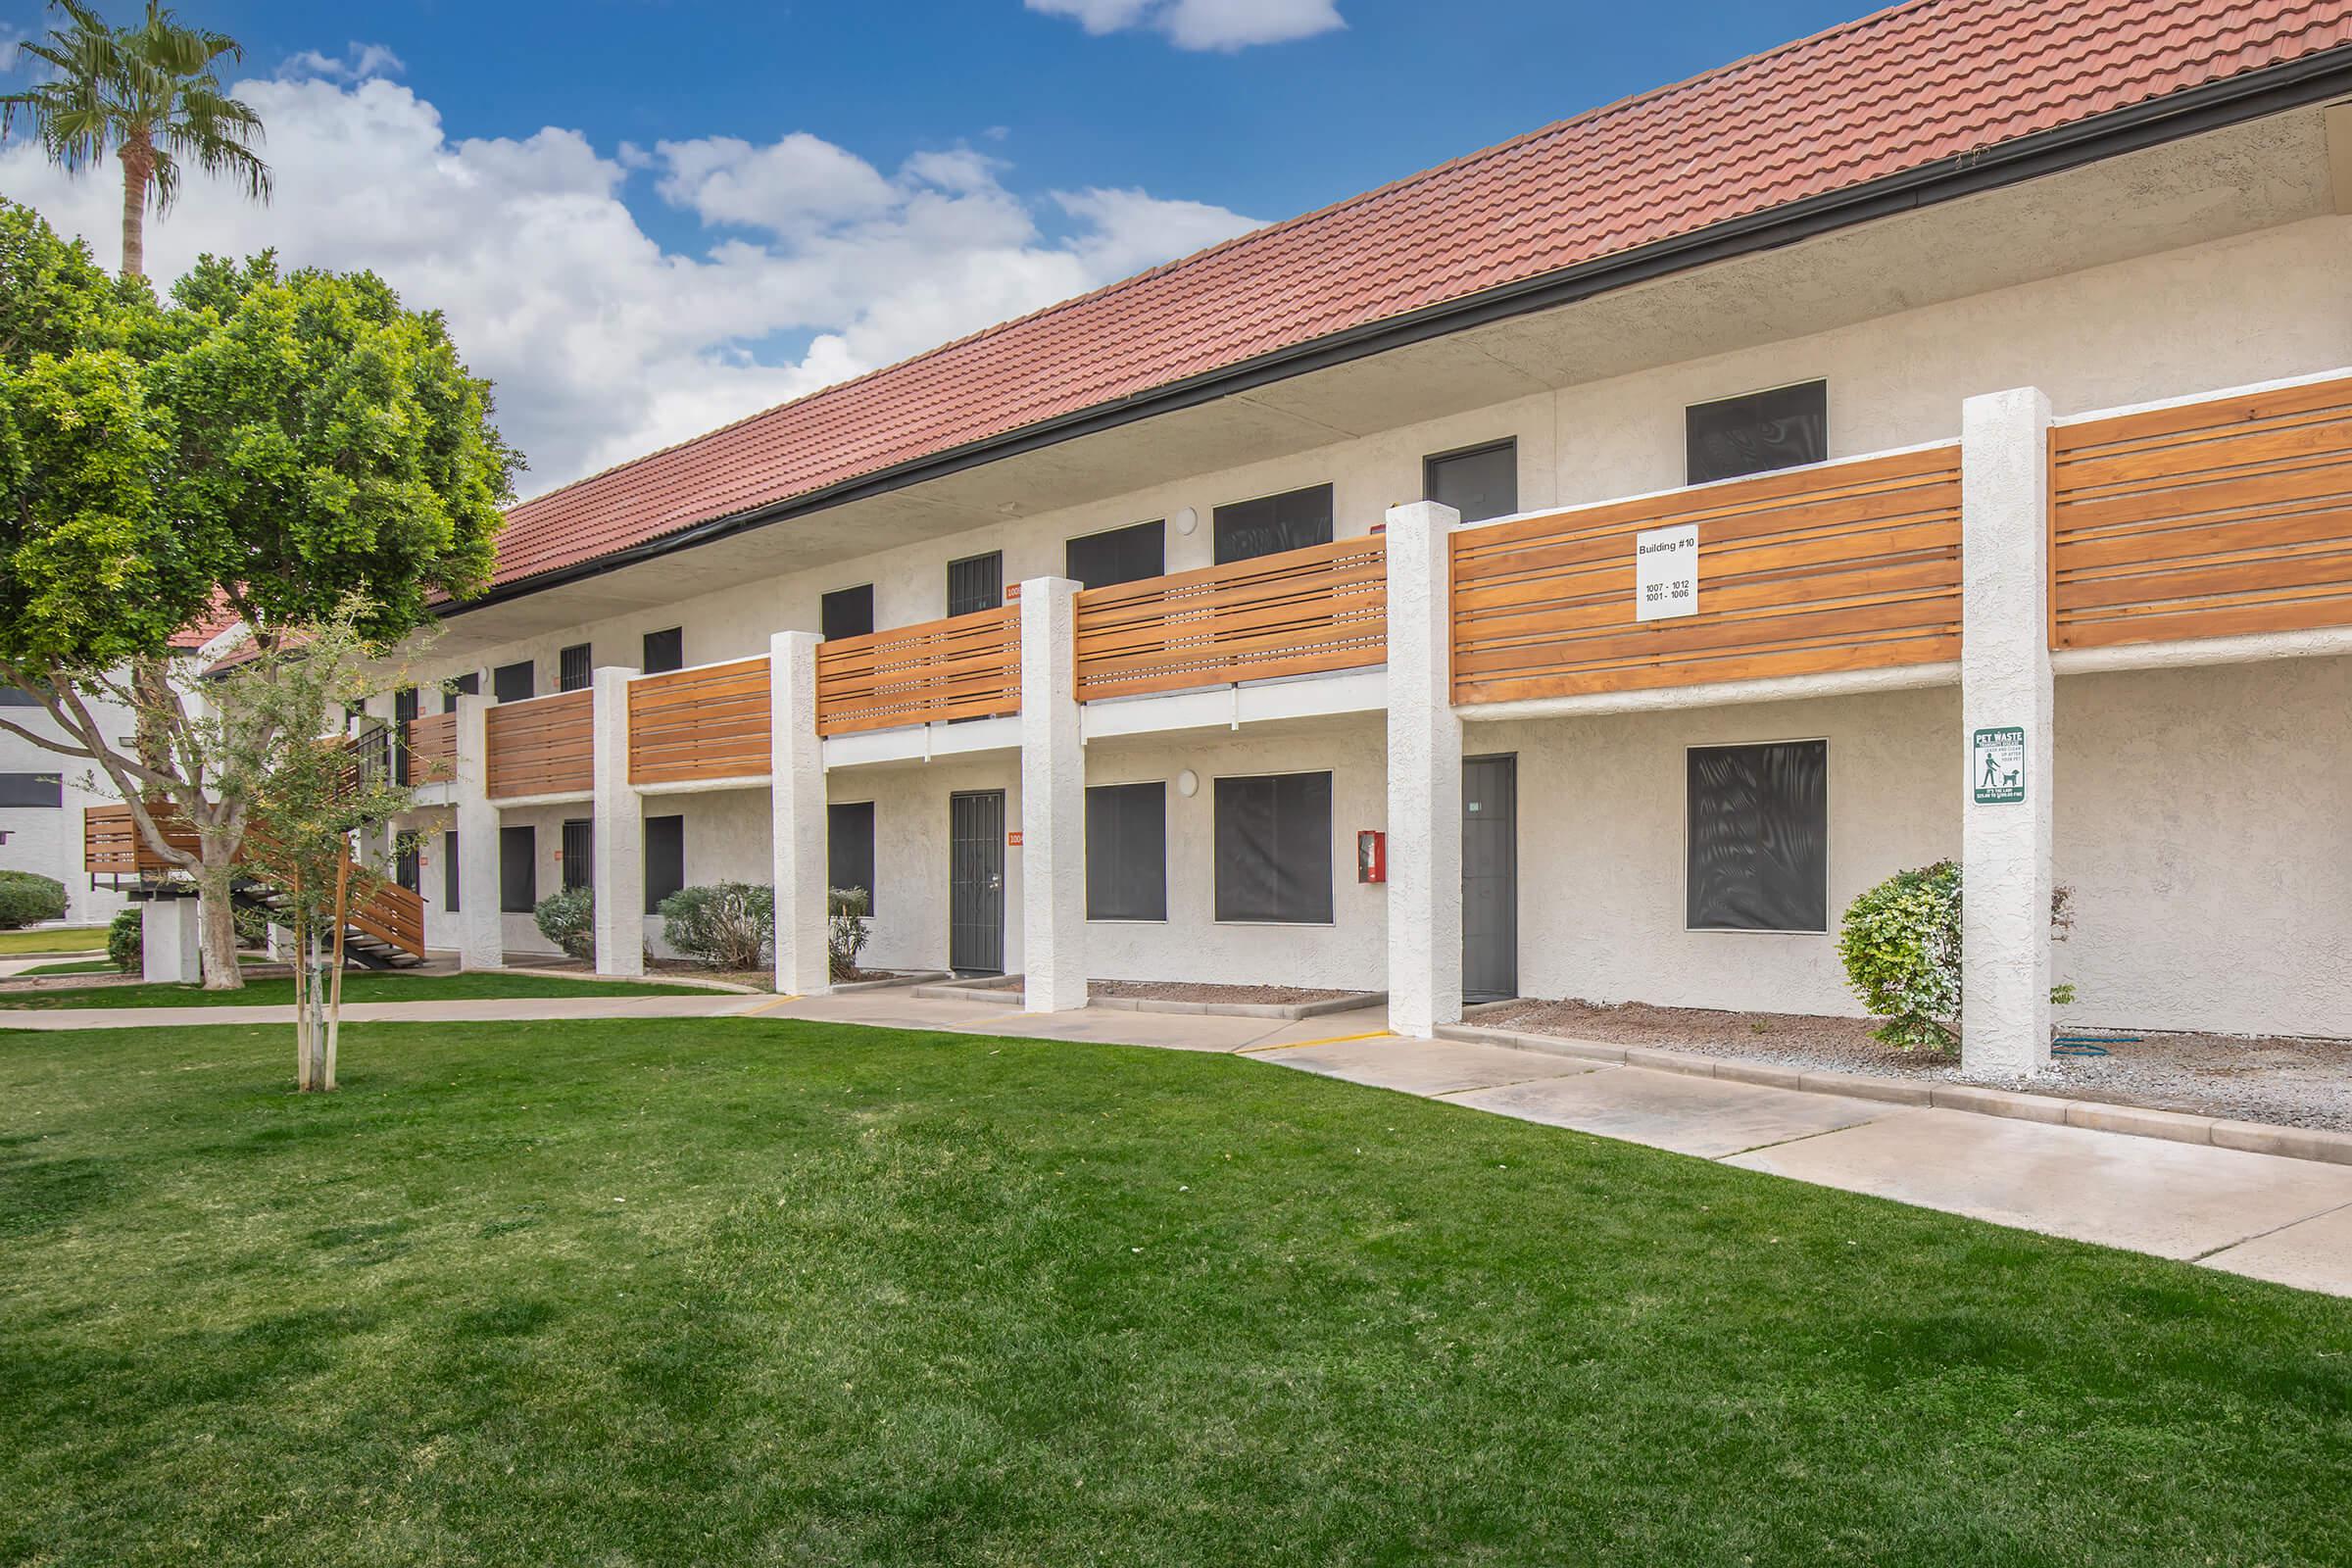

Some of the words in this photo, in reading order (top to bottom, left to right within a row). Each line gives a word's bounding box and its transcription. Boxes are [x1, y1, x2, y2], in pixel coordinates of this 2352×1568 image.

[1639, 542, 1677, 554] Building
[1679, 538, 1694, 549] #10
[1646, 583, 1663, 593] 1007
[1672, 580, 1690, 590] 1012
[1646, 593, 1663, 602] 1001
[1671, 589, 1690, 599] 1006
[1976, 734, 1992, 744] PET
[1993, 732, 2024, 742] WASTE
